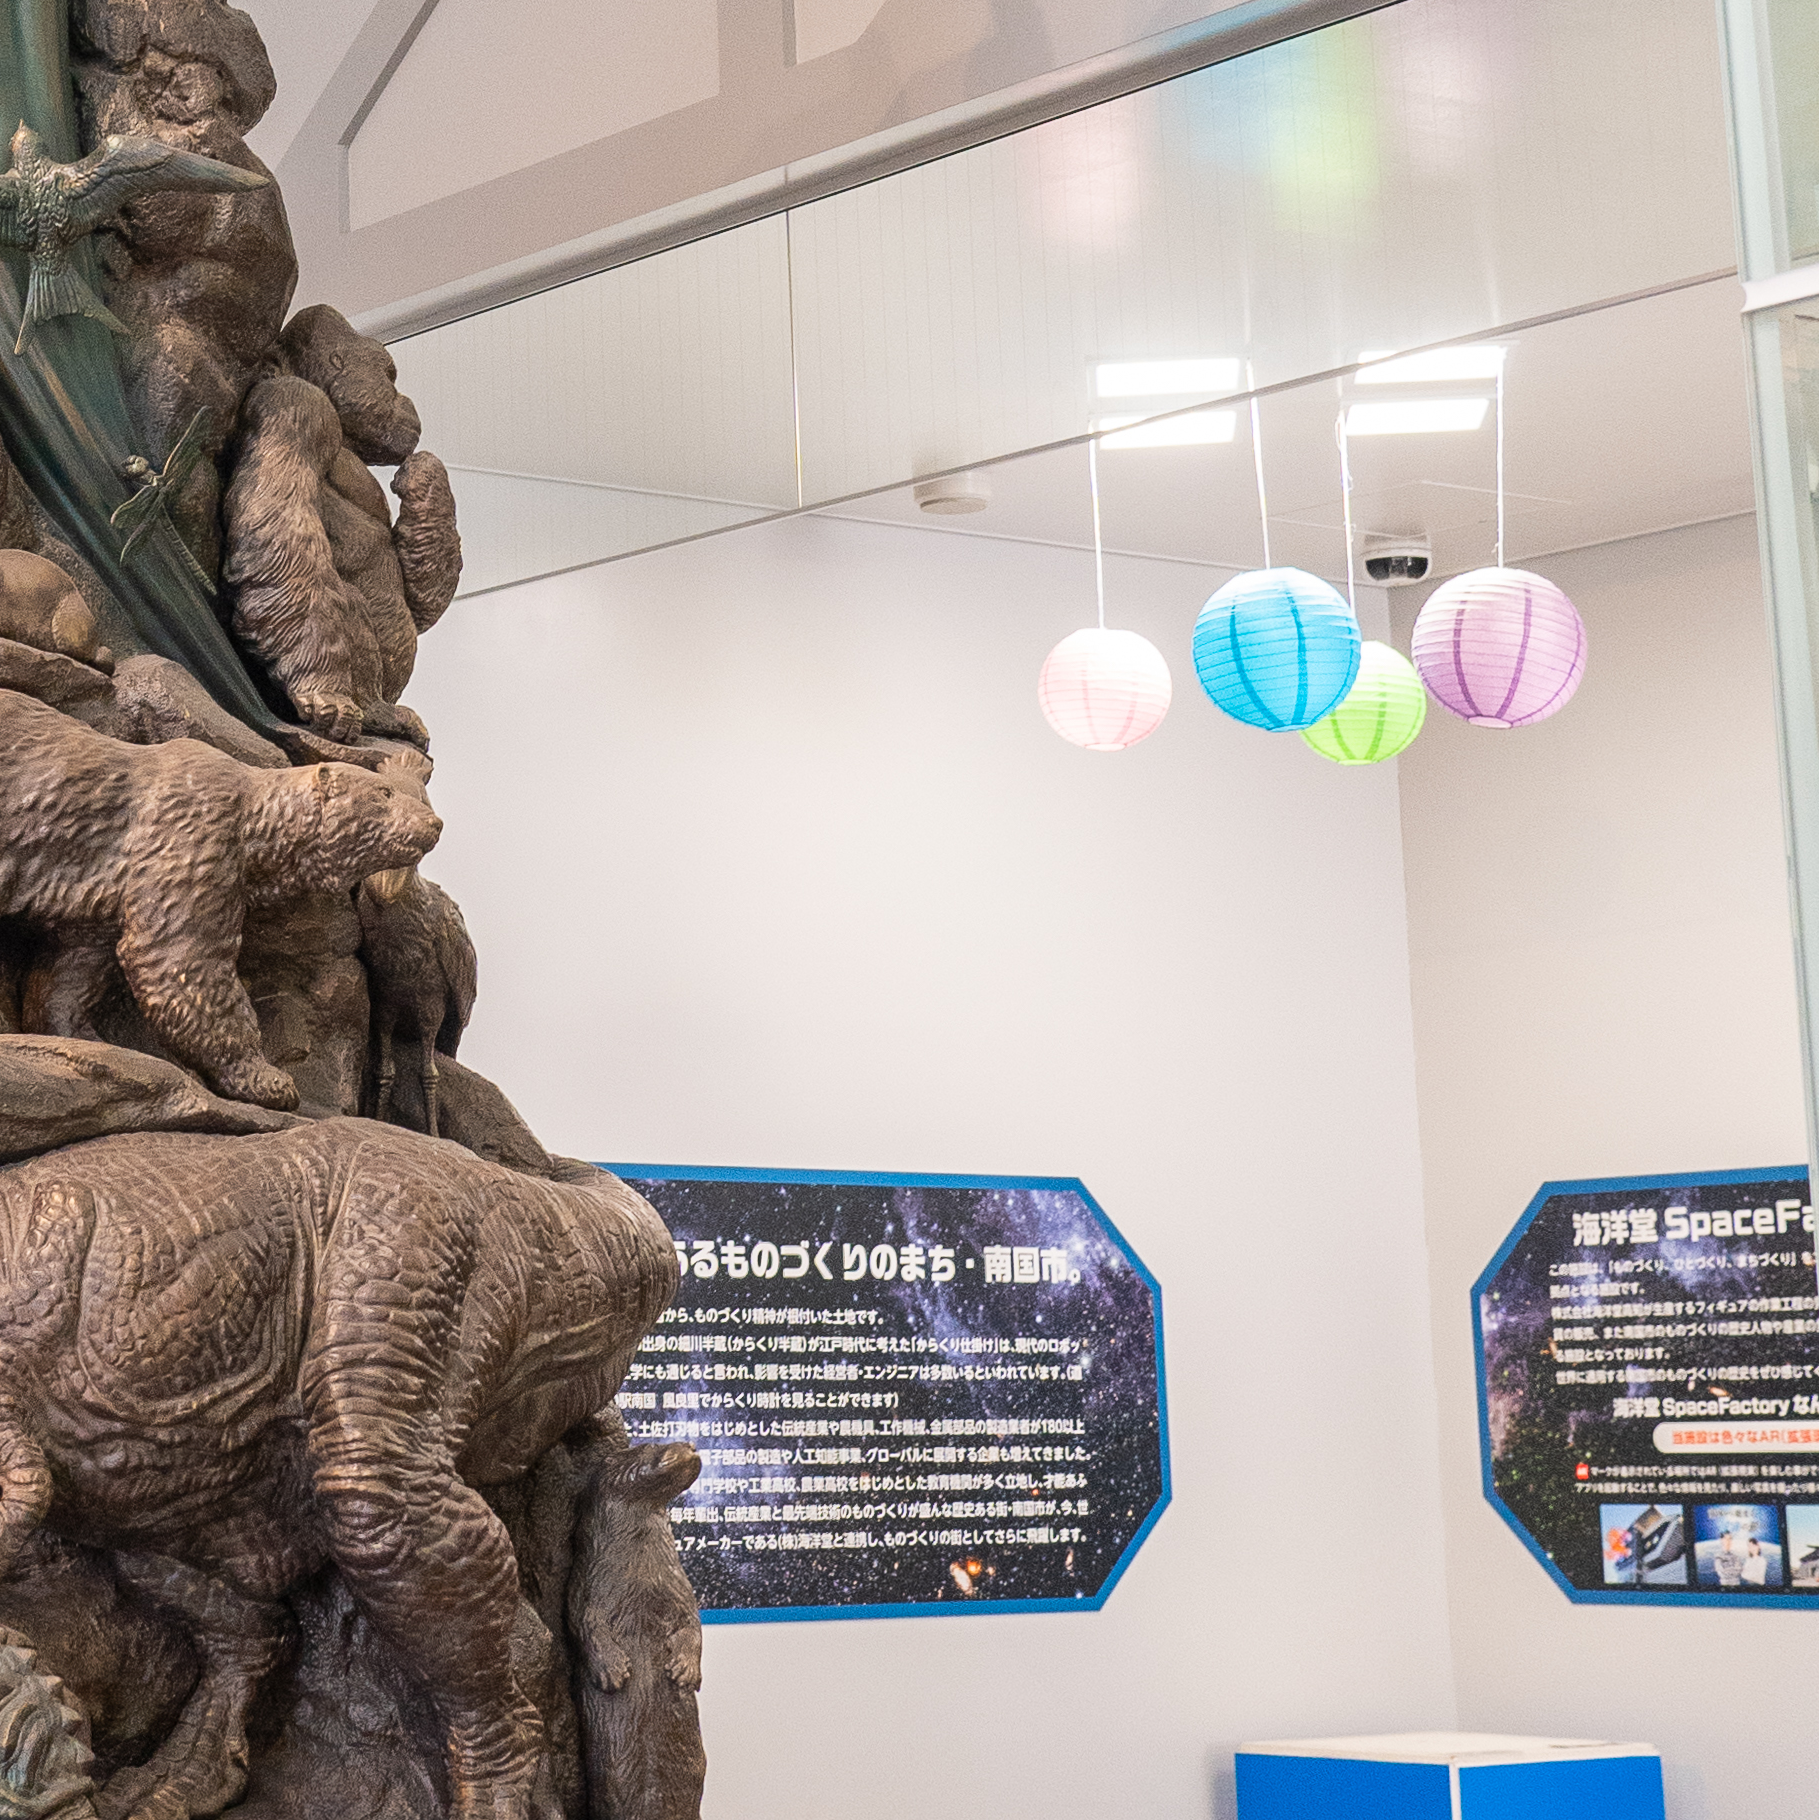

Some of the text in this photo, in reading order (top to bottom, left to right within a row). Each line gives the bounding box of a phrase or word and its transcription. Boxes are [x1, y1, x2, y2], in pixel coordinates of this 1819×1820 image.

[1572, 1207, 1659, 1247] 海洋堂
[637, 1334, 1081, 1354] 出身の細川半蔵(からくり半蔵)が江戸時代に考えた「からくり仕掛け」は、現代のロボッ
[1613, 1397, 1661, 1418] 海洋堂
[1662, 1396, 1790, 1418] SpaceFactory
